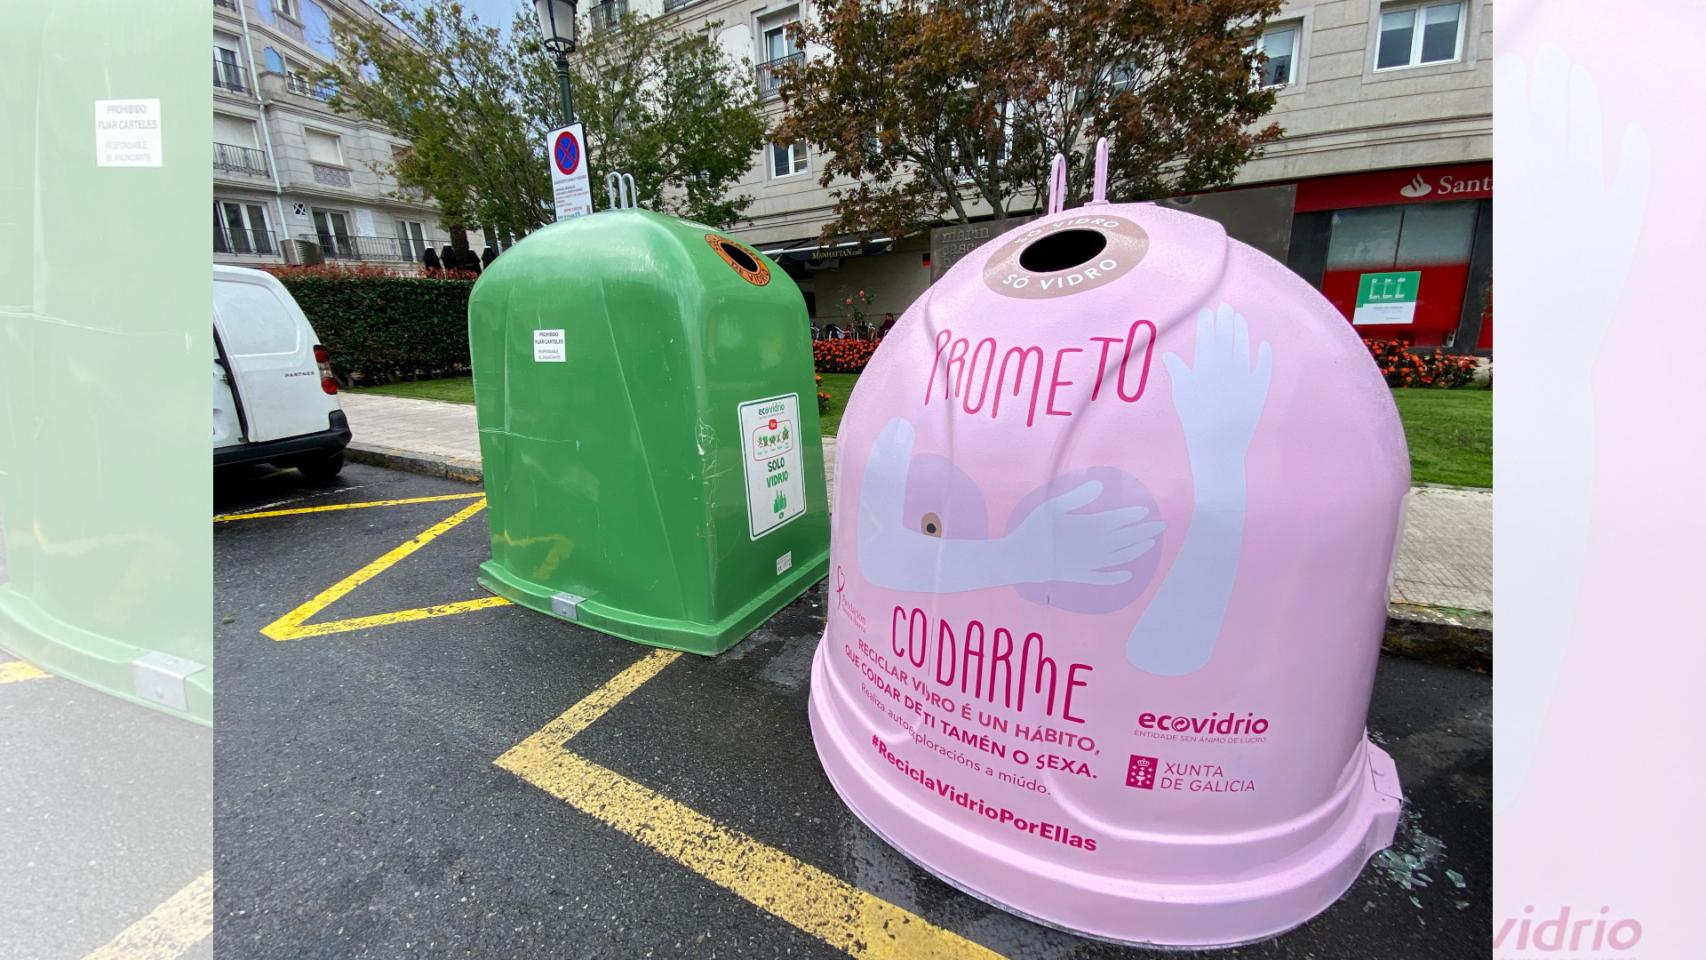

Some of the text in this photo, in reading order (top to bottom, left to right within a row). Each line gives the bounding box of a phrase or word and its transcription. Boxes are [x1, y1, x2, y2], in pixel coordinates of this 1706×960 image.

[1040, 259, 1118, 291] VIDRO
[924, 319, 1157, 428] PROMETO
[758, 402, 785, 416] ecovidrio
[768, 457, 785, 472] SOLO
[766, 470, 789, 489] VIDRIO
[858, 638, 908, 685] RECICLAR
[961, 703, 972, 721] É
[978, 711, 1009, 734] UN
[1015, 724, 1101, 756] HÁBITO,
[845, 644, 1098, 779] QUE COIDAR DE TI TAMÉN O SEXA.
[1138, 712, 1270, 735] ecovidrio
[861, 682, 886, 712] Realiza
[985, 767, 994, 776] a
[998, 771, 1052, 796] miúdo.
[1134, 729, 1178, 742] ENTIDADE
[1180, 734, 1197, 743] SEN
[1163, 762, 1224, 778] XUNTA
[872, 733, 1098, 852] #ReciclaVidrioPorEllas
[1160, 777, 1256, 793] DE GALICIA
